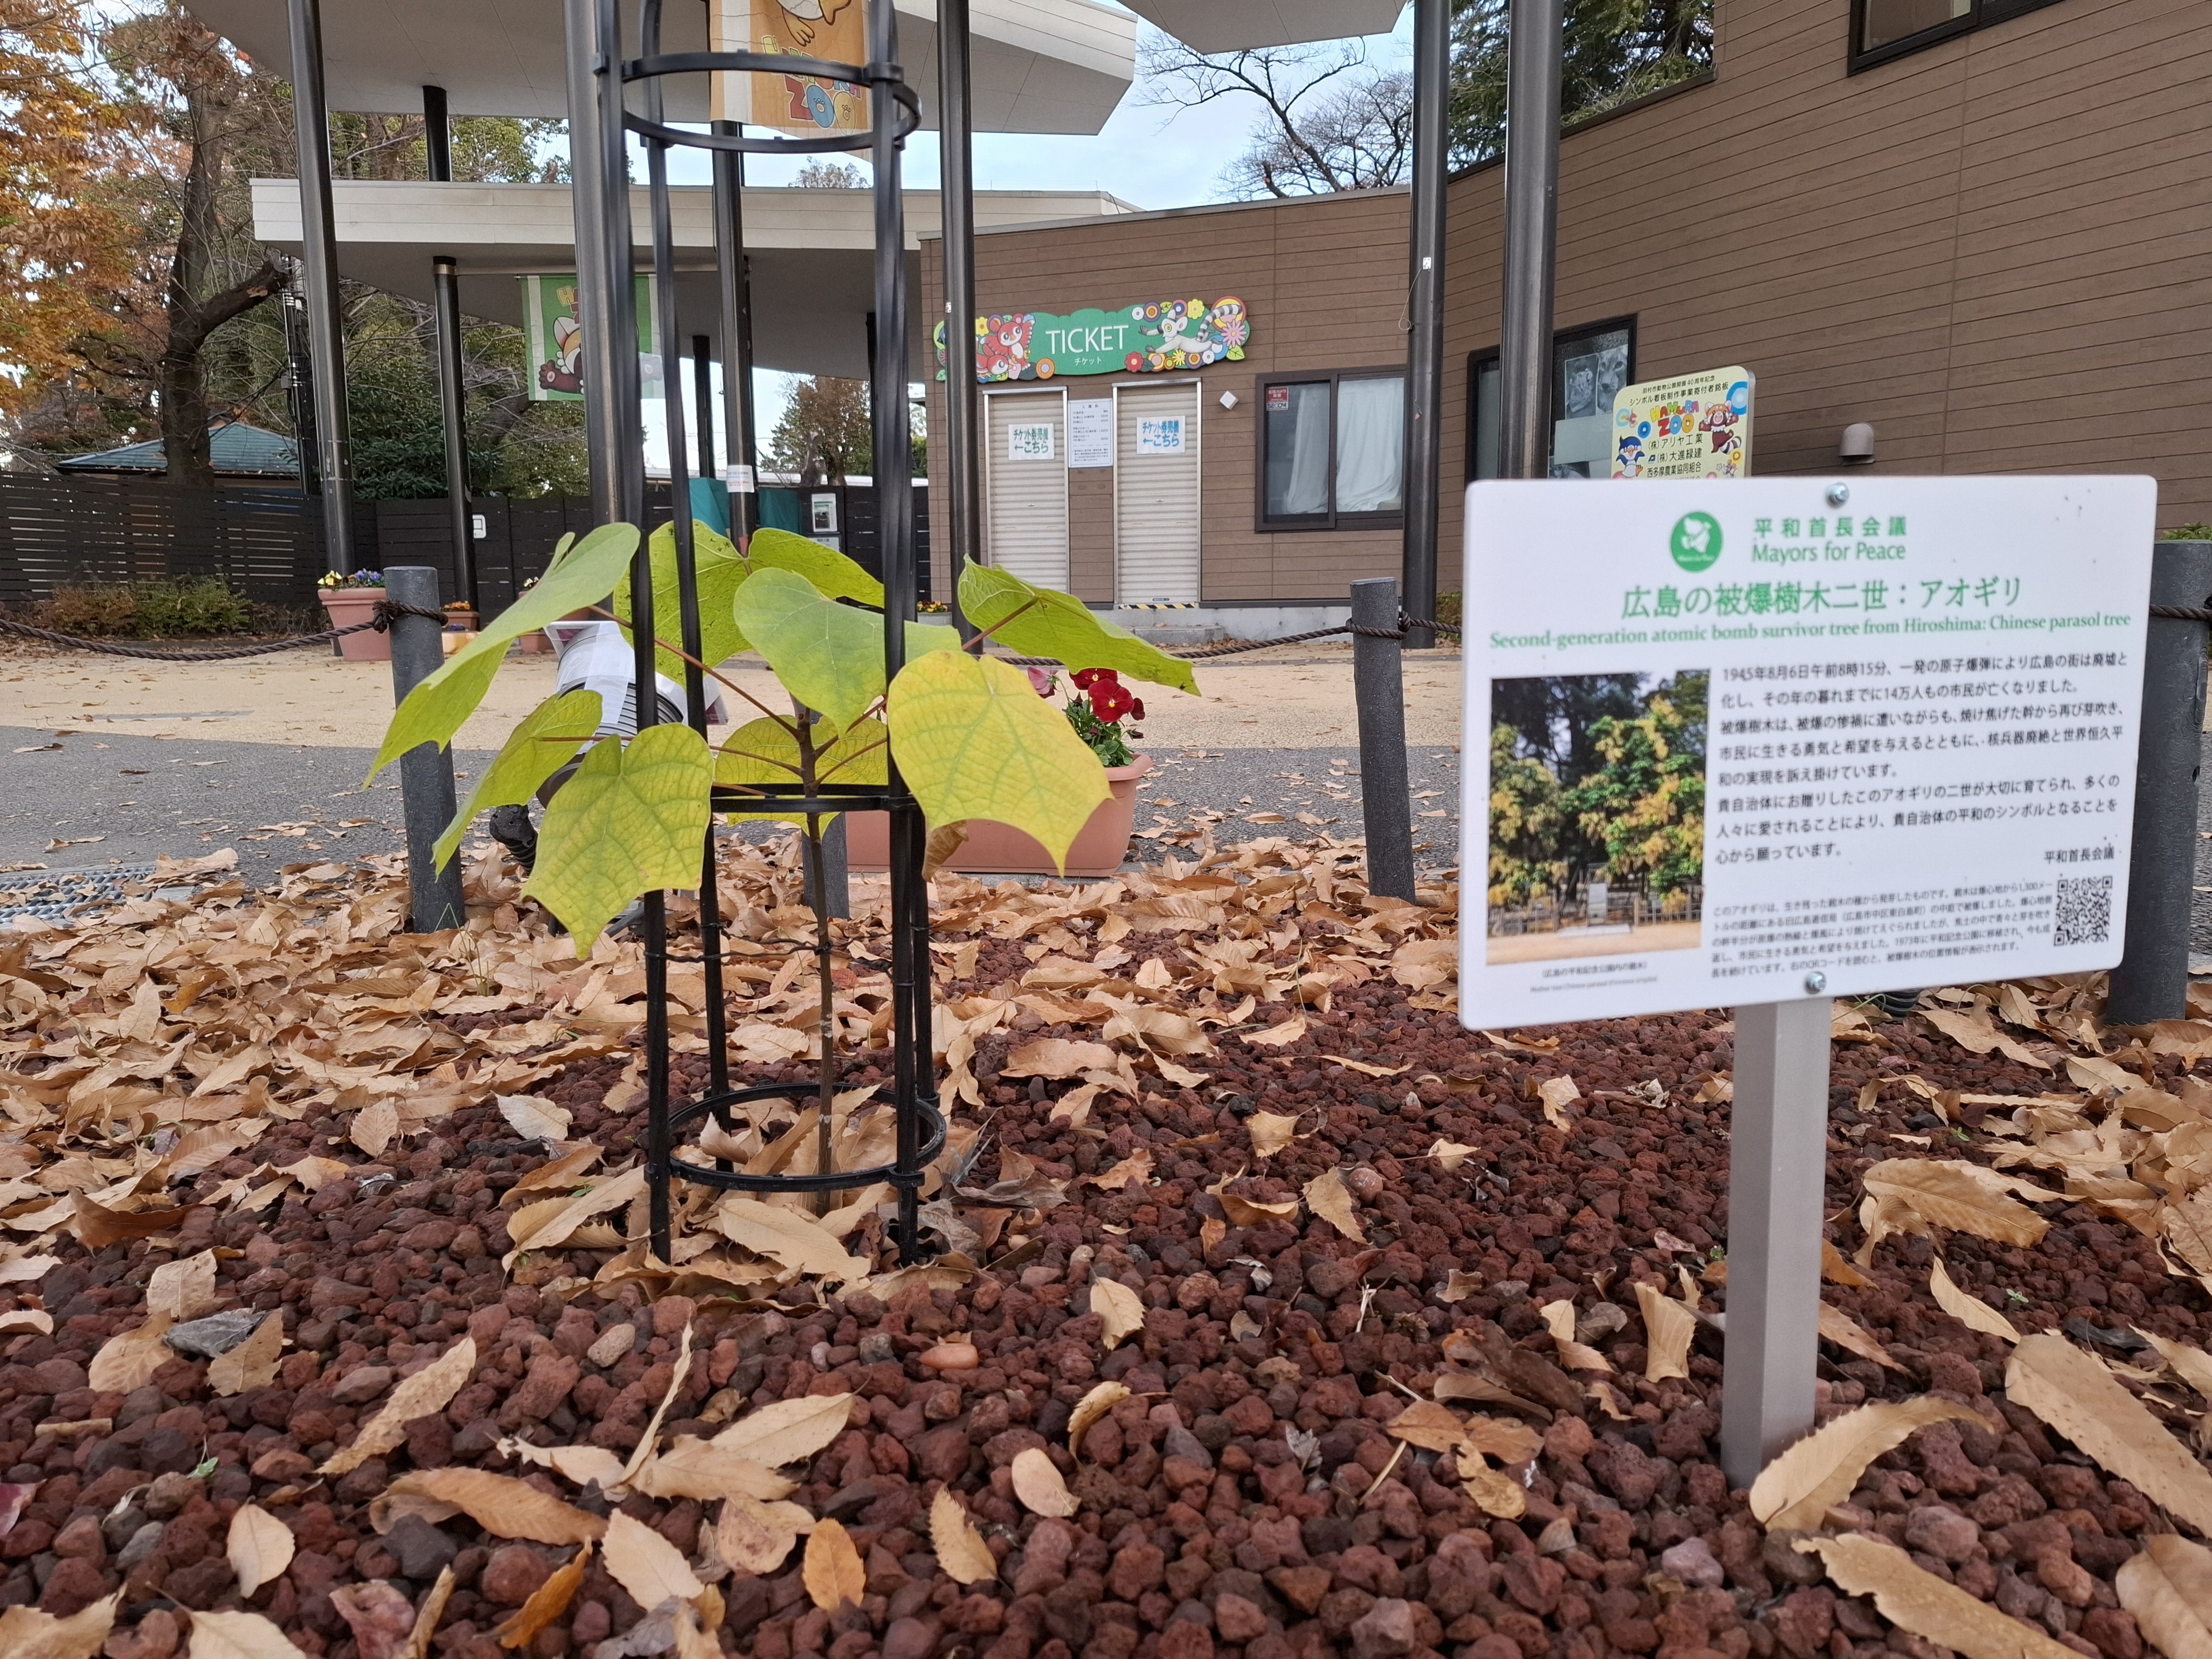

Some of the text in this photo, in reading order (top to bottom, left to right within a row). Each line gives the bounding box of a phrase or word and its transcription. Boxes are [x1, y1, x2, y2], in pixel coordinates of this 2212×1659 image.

[784, 74, 857, 136] ZOO
[1045, 325, 1129, 355] TICKET
[1074, 357, 1102, 366] チケット
[1650, 400, 1700, 422] HAMURA
[1657, 413, 1695, 437] ZOO
[1024, 440, 1049, 454] こちら
[1153, 434, 1179, 447] こちら
[1648, 433, 1703, 450] (株)アリヤ工業
[1657, 448, 1702, 462] (株)大進緑建
[1647, 461, 1702, 478] 西多摩農業協同組合
[1754, 516, 1906, 539] 平和首長会議
[1752, 542, 1906, 565] Mayors for Peace
[1622, 576, 2021, 619] 広島の被爆樹木二世：アオギリ
[1490, 612, 2131, 650] Second-generation atomic bomb survivor tree from Hiroshima: Chinese parasol tree
[1723, 652, 2127, 681] 1945年8月6日午前8時15分、一発の原子爆弾により広島の街は廃墟と
[1720, 678, 2078, 709] 化し、その年の暮れまでに14万人もの市民が亡くなりました。
[1718, 763, 1897, 787] 和の実現を訴え掛けています。
[1718, 774, 2120, 813] 貴自治体にお贈りしたこのアオギリの二世が大切に育てられ、多くの
[1716, 798, 2117, 839] 人々に愛されることにより、貴自治体の平和のシンボルとなることを
[1715, 843, 1841, 864] 心から願っています。
[2044, 846, 2114, 864] 平和首長会議
